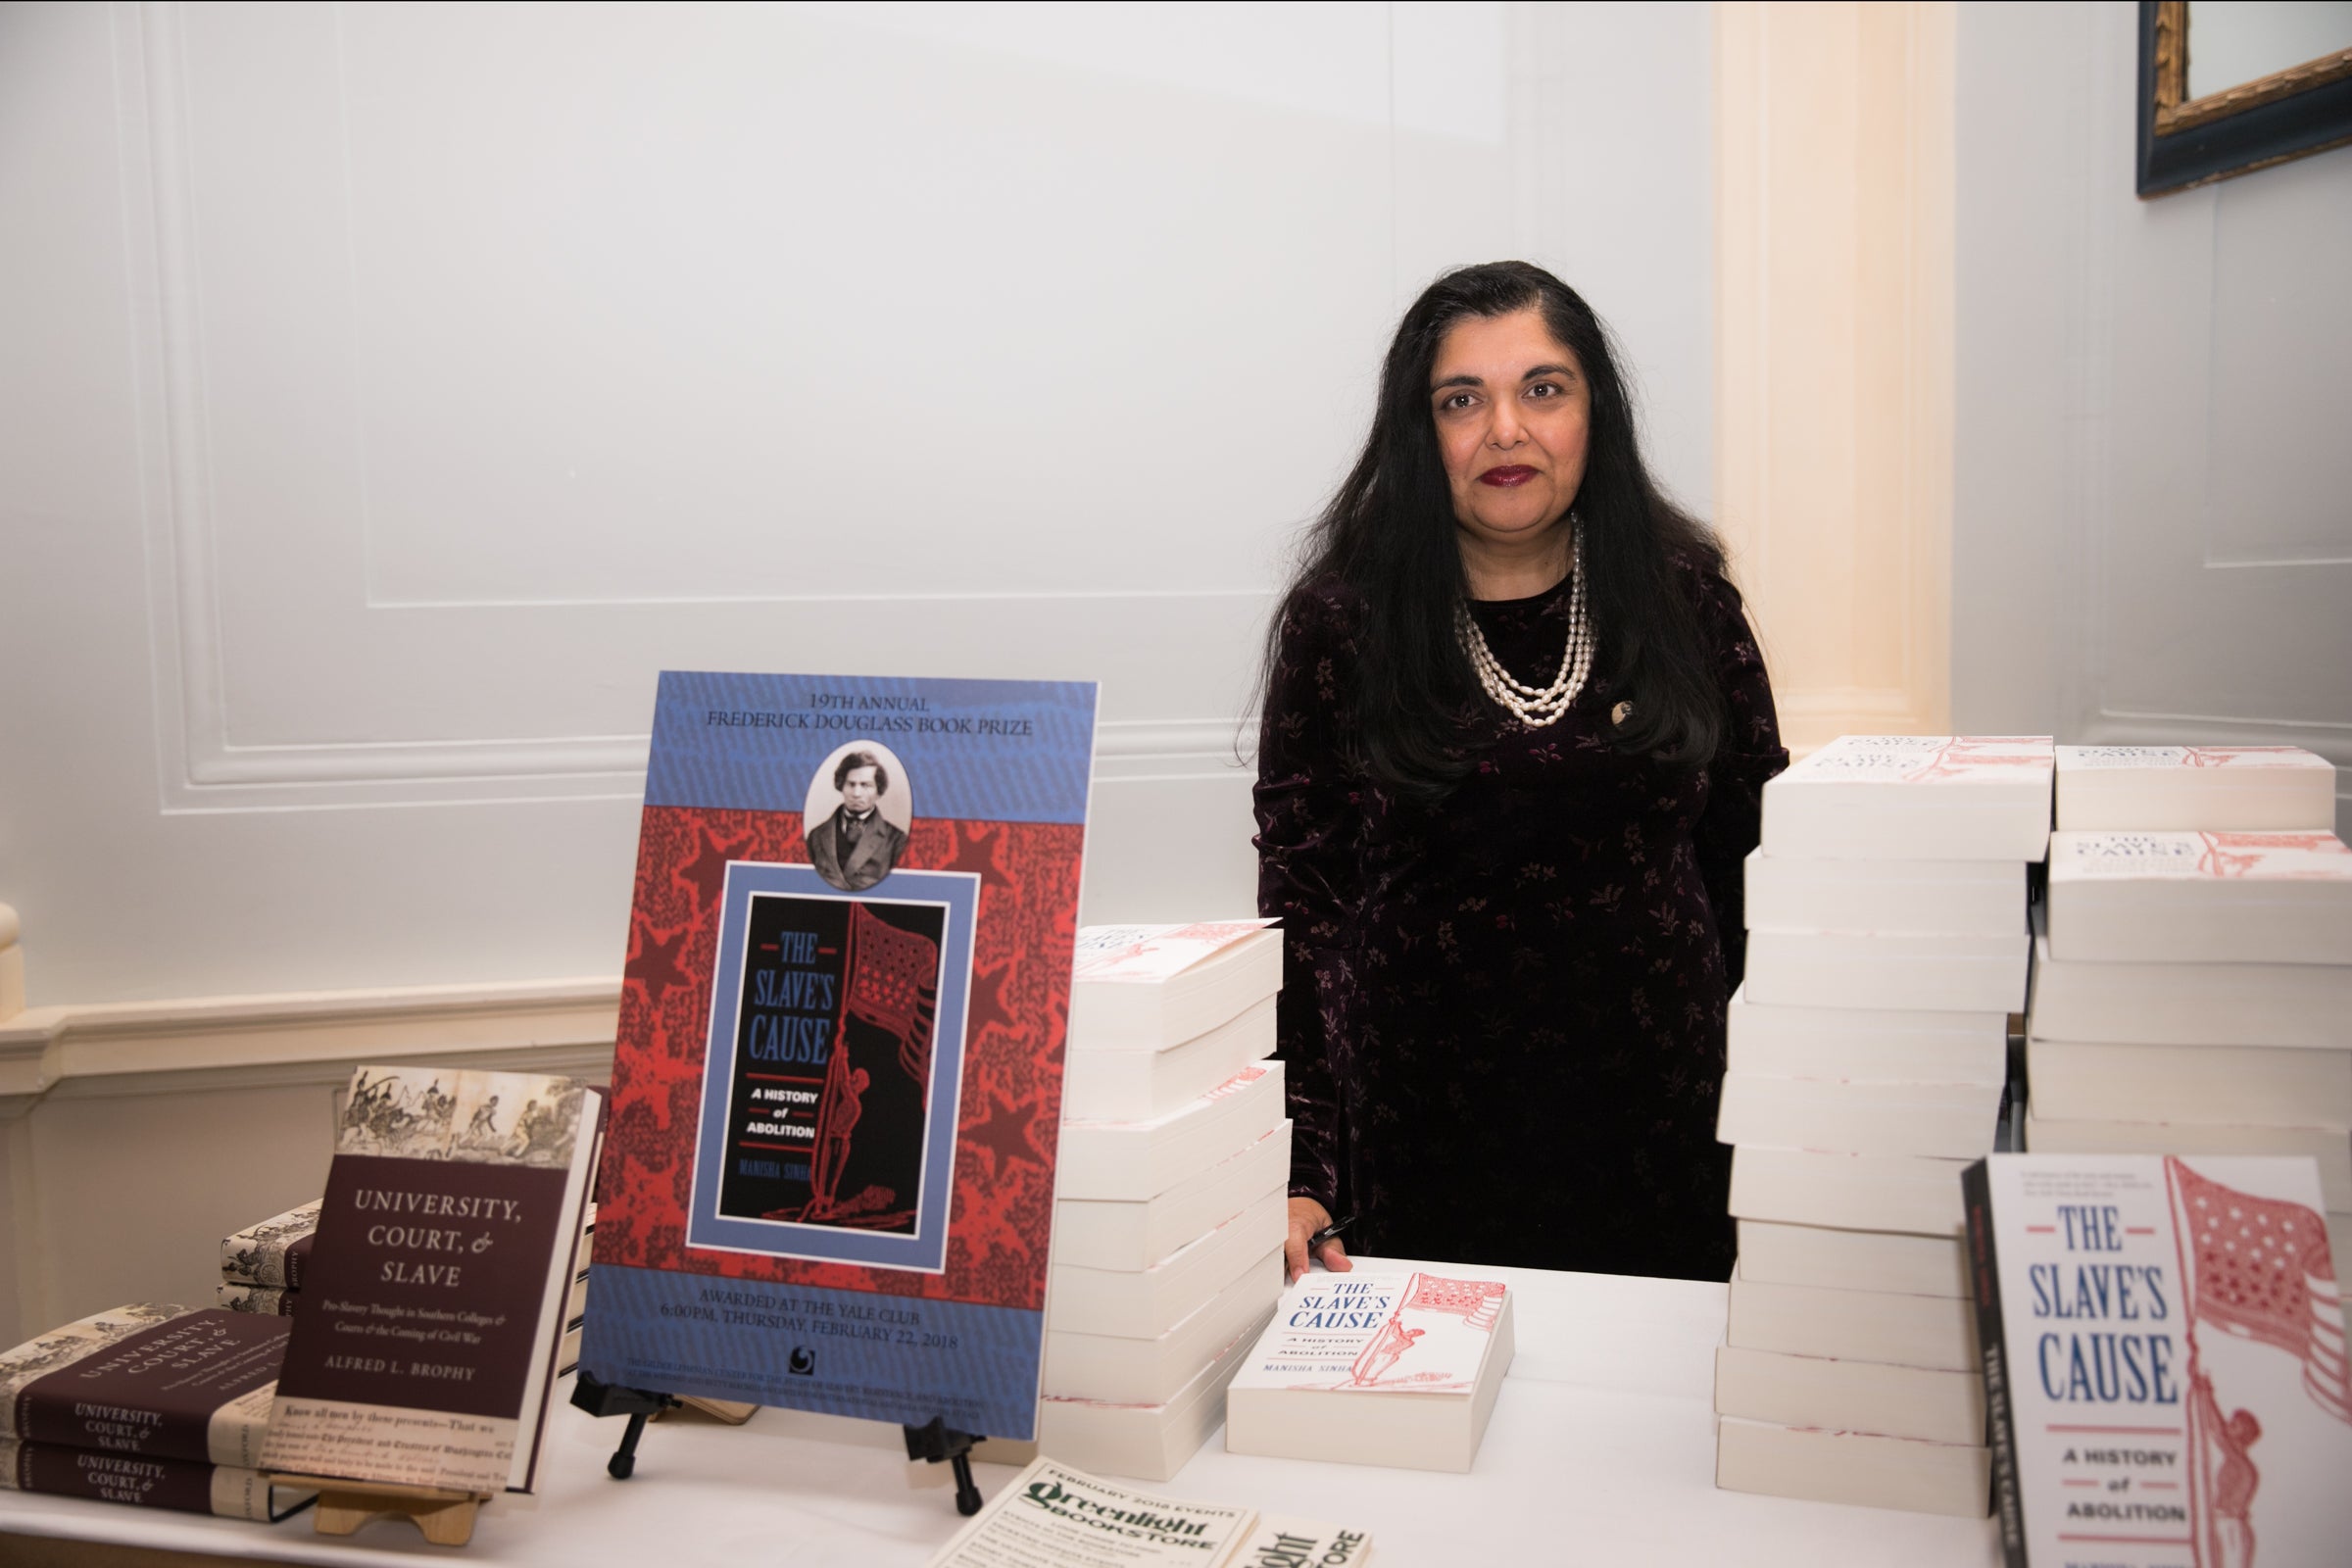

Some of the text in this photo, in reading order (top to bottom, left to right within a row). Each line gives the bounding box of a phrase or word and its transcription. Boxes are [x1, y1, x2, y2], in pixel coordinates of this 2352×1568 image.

[809, 694, 930, 711] 19TH ANNUAL
[708, 710, 1033, 735] FREDERICK DOUGLASS BOOK PRIZE
[782, 931, 817, 964] THE
[755, 969, 834, 1010] SLAVE'S
[749, 1014, 830, 1065] CAUSE
[751, 1088, 819, 1104] A HISTORY
[773, 1107, 788, 1119] of
[747, 1122, 815, 1139] ABOLITION
[355, 1190, 522, 1223] UNIVERSITY,
[368, 1225, 493, 1254] COURT, &
[2058, 1204, 2123, 1251] THE
[381, 1261, 462, 1288] SLAVE
[1334, 1283, 1373, 1294] THE
[2029, 1263, 2169, 1322] SLAVE'S
[700, 1289, 920, 1324] AWARDED AT THE YALE CLUB
[1298, 1297, 1391, 1309] SLAVE'S
[722, 1310, 808, 1332] THURSDAY,
[811, 1322, 894, 1342] FEBRUARY
[897, 1331, 918, 1347] 22,
[922, 1333, 958, 1349] 2018
[1289, 1311, 1383, 1329] CAUSE
[172, 1340, 241, 1369] SLAVE
[325, 1355, 476, 1381] ALFRED L. BROPHY
[1984, 1344, 2001, 1391] THE
[2037, 1333, 2180, 1405] CAUSE
[74, 1402, 163, 1427] UNIVERSITY,
[77, 1454, 166, 1480] UNIVERSITY,
[2063, 1448, 2178, 1467] A HISTORY
[1048, 1469, 1236, 1518] FEBRUARY 2018 EVENTS
[2108, 1476, 2131, 1493] of
[2068, 1502, 2186, 1523] ABOLITION
[1051, 1505, 1218, 1549] BOOKSTORE
